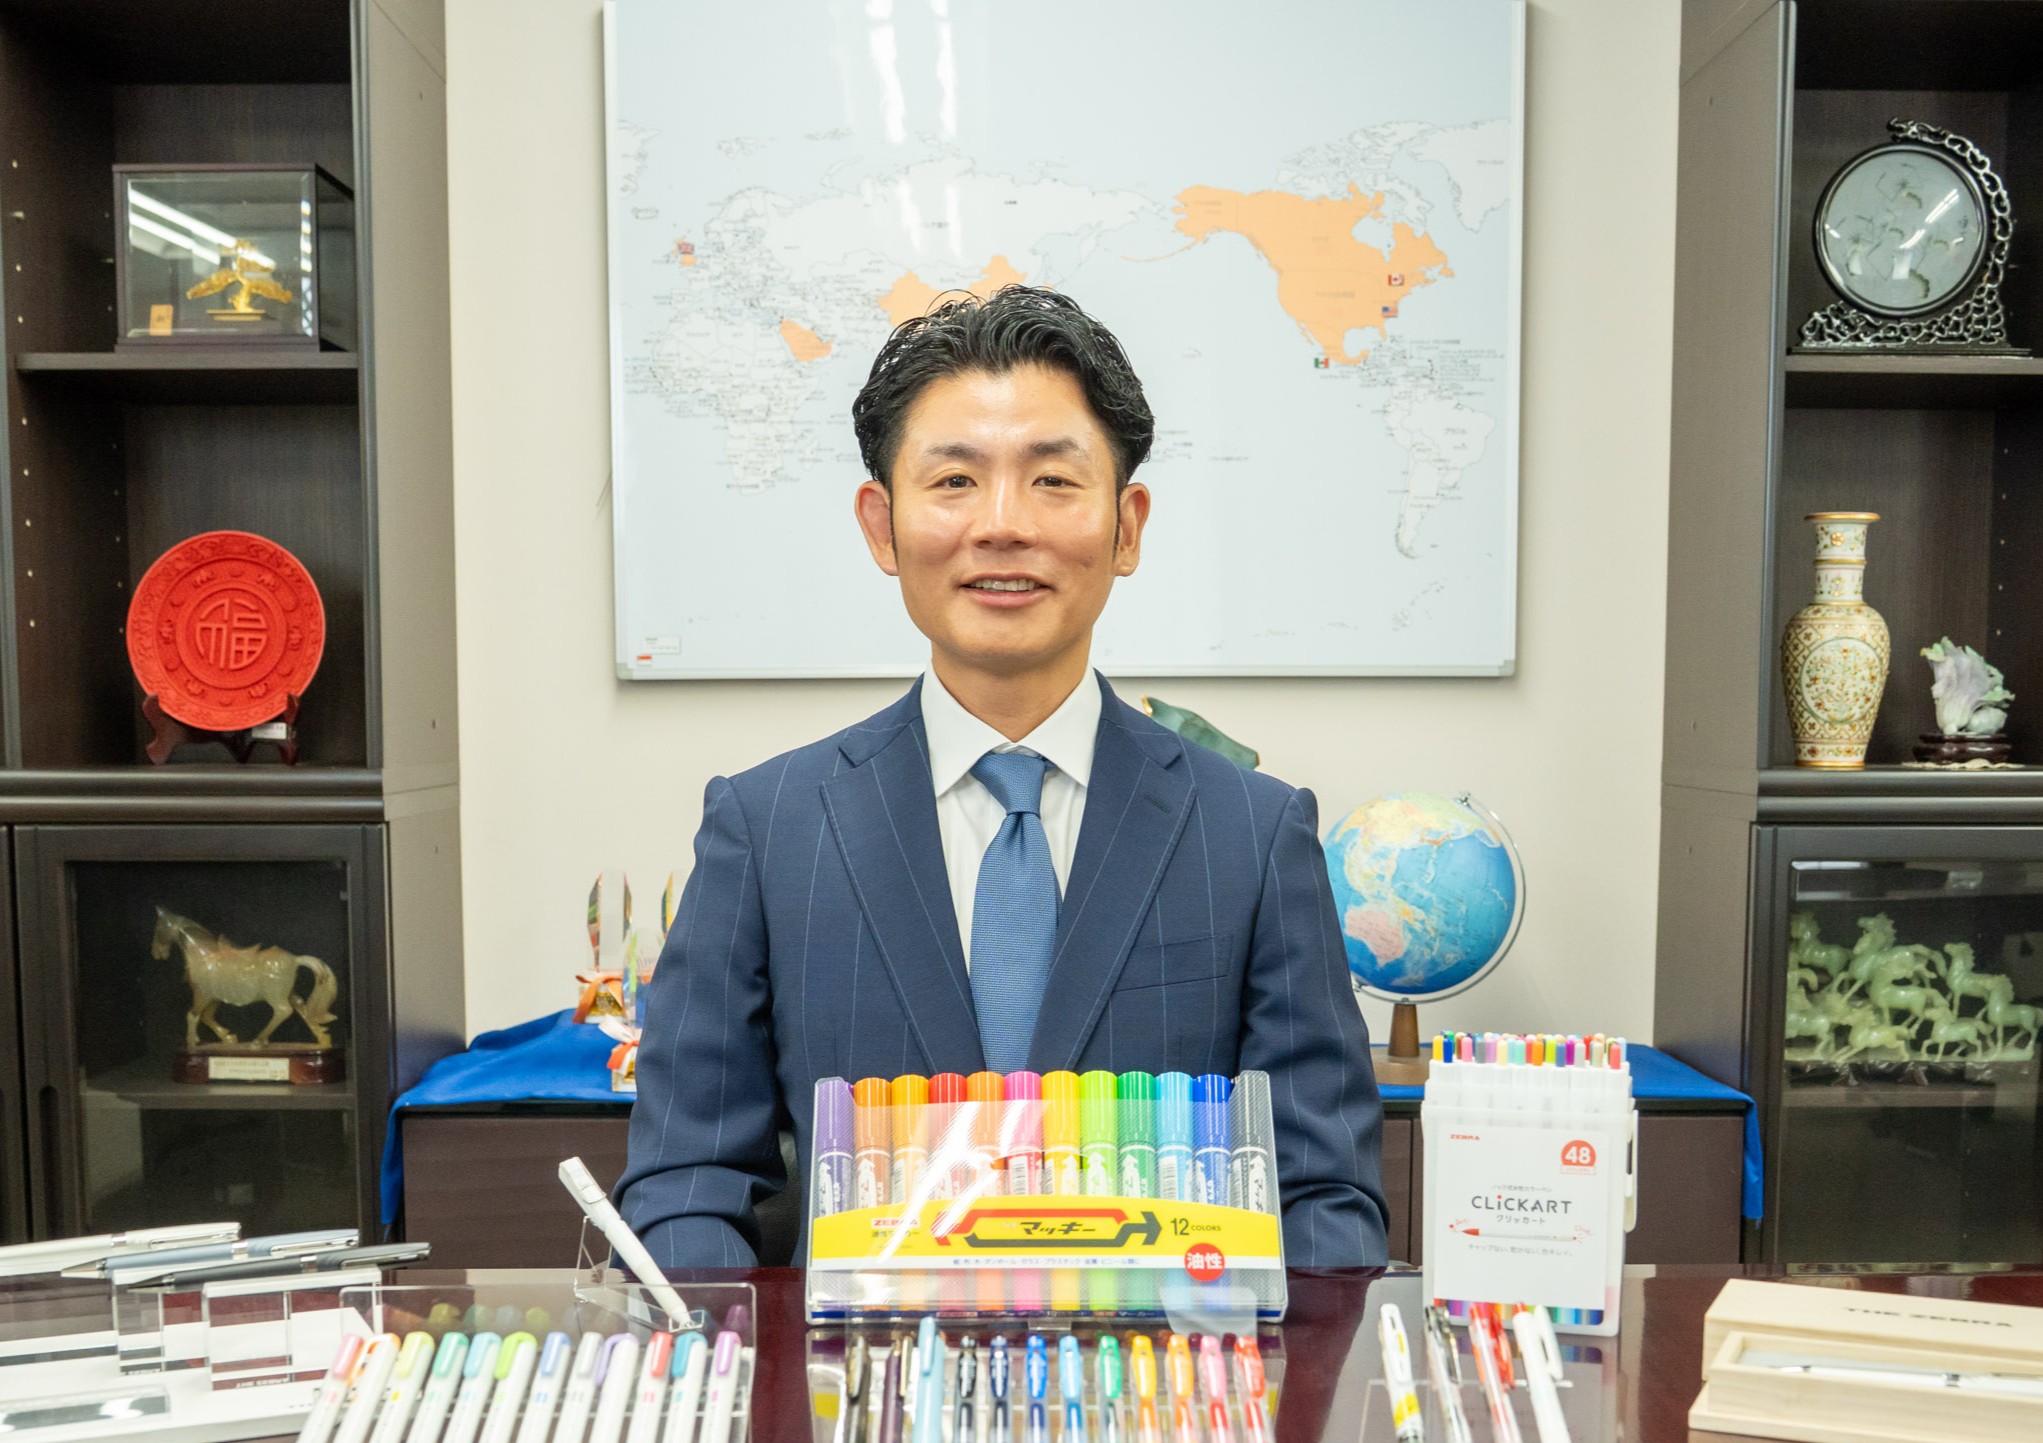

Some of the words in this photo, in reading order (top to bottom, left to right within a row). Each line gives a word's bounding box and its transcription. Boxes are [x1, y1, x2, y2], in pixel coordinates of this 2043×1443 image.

[196, 598, 268, 670] 福
[1565, 1145, 1592, 1165] 48
[873, 1219, 919, 1227] ZEBA
[1019, 1221, 1096, 1235] マッキー
[1170, 1218, 1190, 1236] 12
[1191, 1224, 1222, 1232] COLORS
[1496, 1214, 1547, 1225] クリッカート
[1187, 1253, 1223, 1270] 油性
